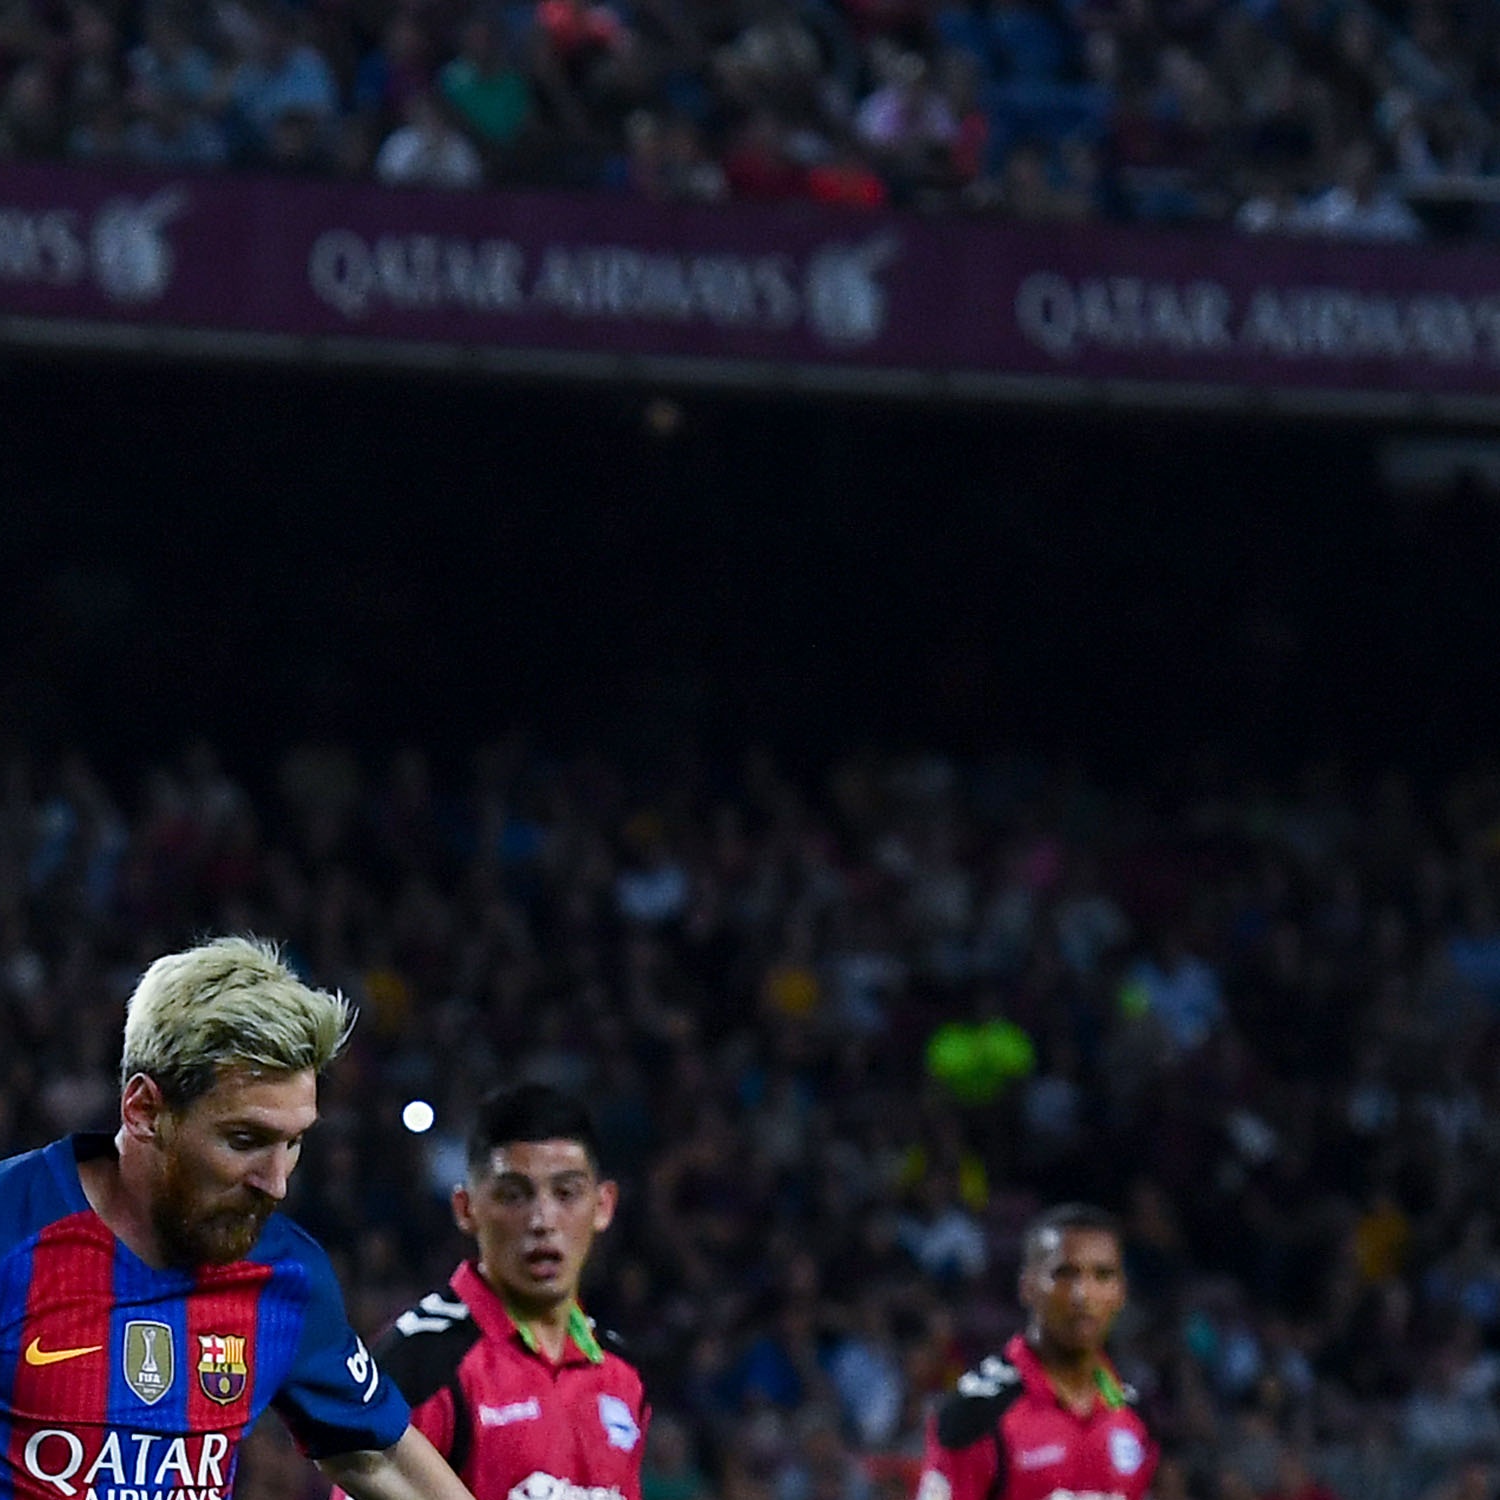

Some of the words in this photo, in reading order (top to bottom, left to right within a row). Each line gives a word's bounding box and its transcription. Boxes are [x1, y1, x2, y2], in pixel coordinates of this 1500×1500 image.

[307, 228, 526, 321] QATAR
[1014, 270, 1233, 360] QATAR
[24, 1428, 229, 1496] QATAR
